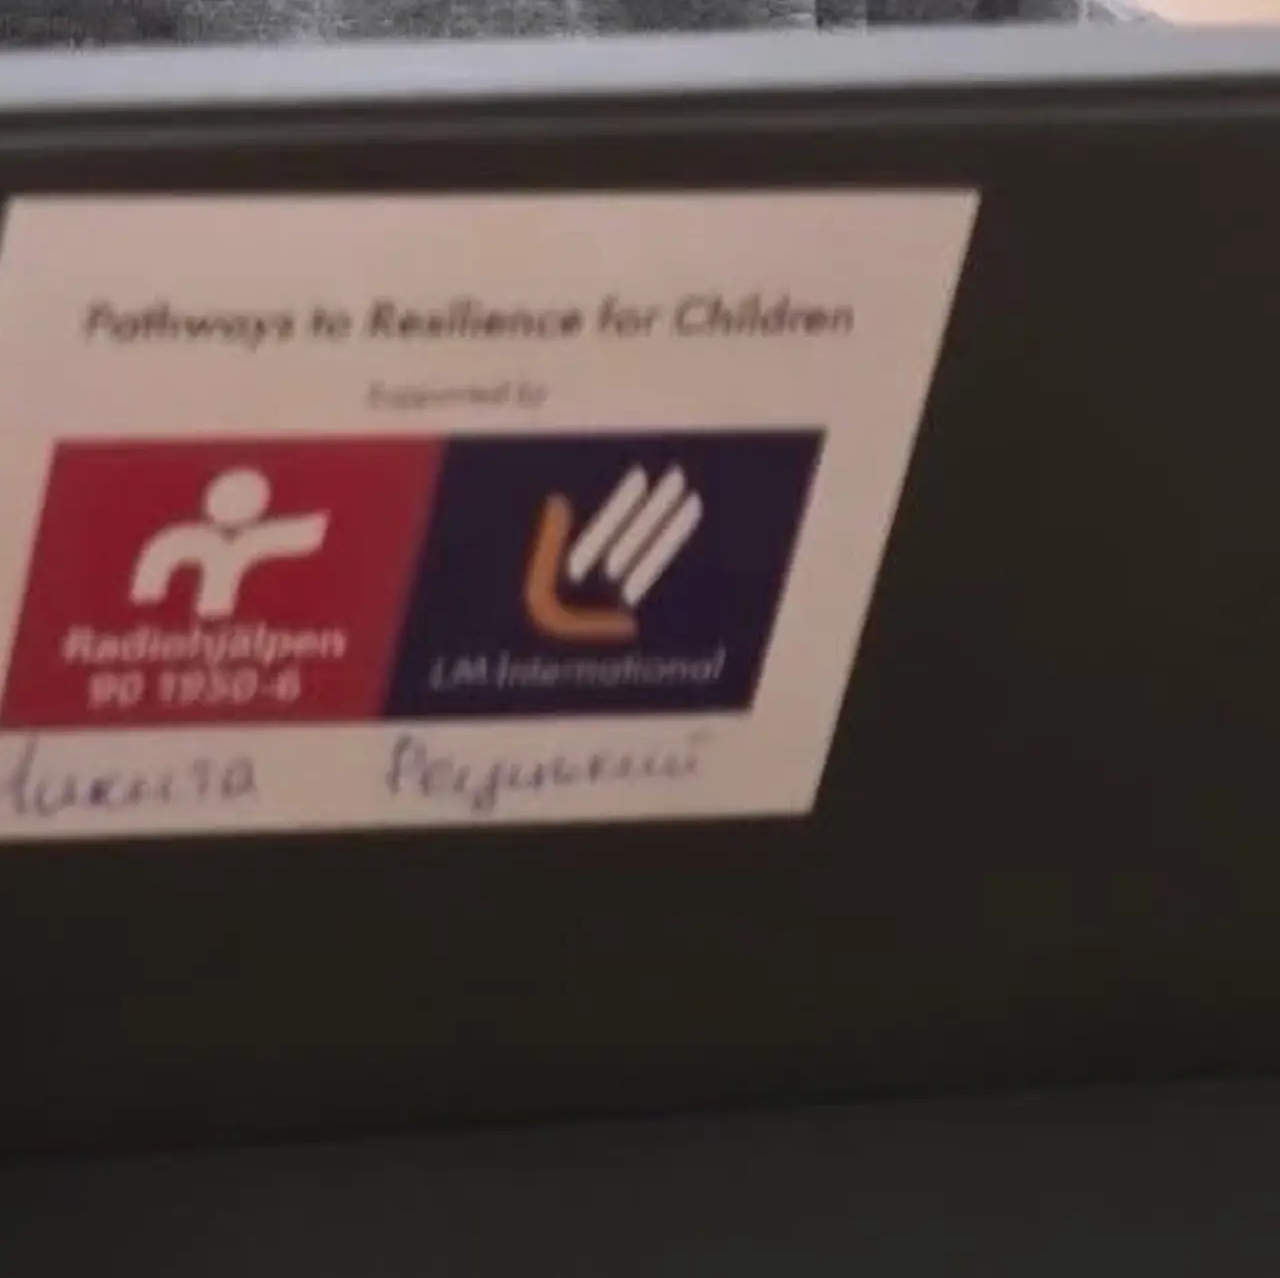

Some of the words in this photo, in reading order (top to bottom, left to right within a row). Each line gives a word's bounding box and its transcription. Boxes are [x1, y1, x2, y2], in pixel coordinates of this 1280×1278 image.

[83, 297, 294, 349] Pathways
[313, 305, 352, 339] to
[369, 297, 582, 339] Resilience
[598, 293, 658, 337] for
[674, 293, 855, 337] Children
[429, 655, 487, 688] LM
[496, 643, 726, 688] International
